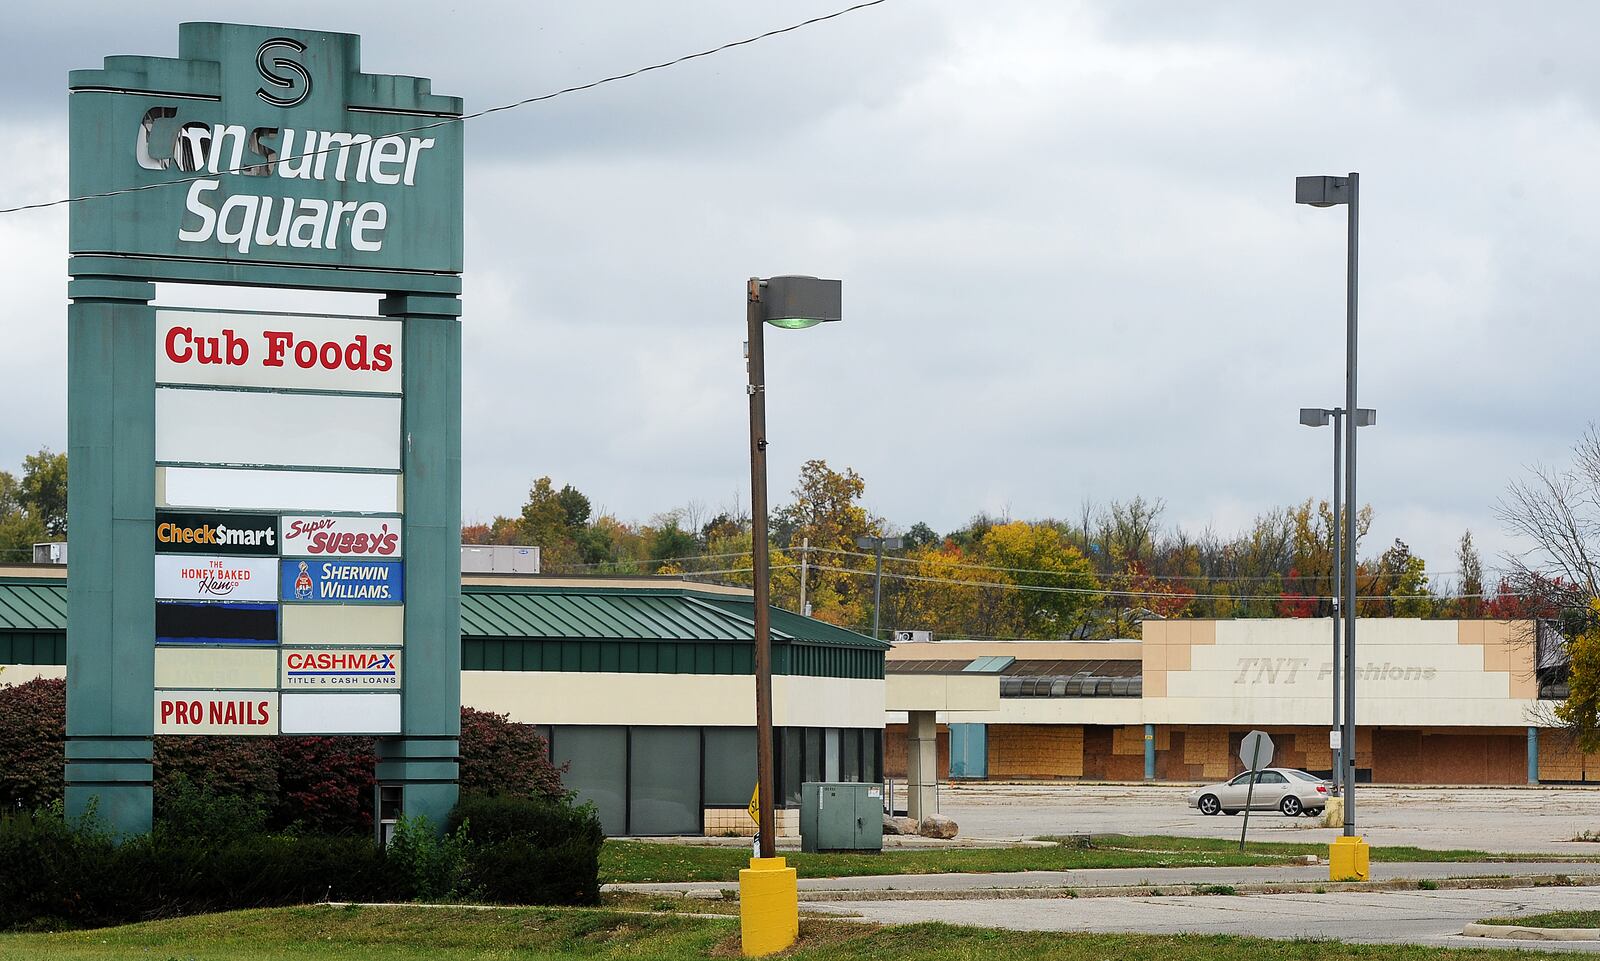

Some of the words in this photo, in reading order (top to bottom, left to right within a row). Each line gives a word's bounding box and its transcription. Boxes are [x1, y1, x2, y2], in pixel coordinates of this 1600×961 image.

[136, 106, 435, 187] Consumer
[178, 180, 388, 254] Square
[165, 326, 250, 367] Cub
[262, 330, 393, 372] Foods
[157, 522, 275, 547] Check$mart
[285, 518, 336, 540] Super
[307, 523, 399, 555] SUBBY'S
[181, 568, 214, 579] HONEY
[217, 569, 251, 580] BAKED
[209, 560, 223, 569] THE
[321, 562, 389, 581] SHERWIN
[198, 576, 233, 596] Ham
[287, 653, 395, 670] CASHMAX
[1233, 657, 1309, 685] TNT
[1317, 662, 1437, 681] Fshions
[161, 700, 203, 725] PRO
[209, 701, 269, 726] NAILS
